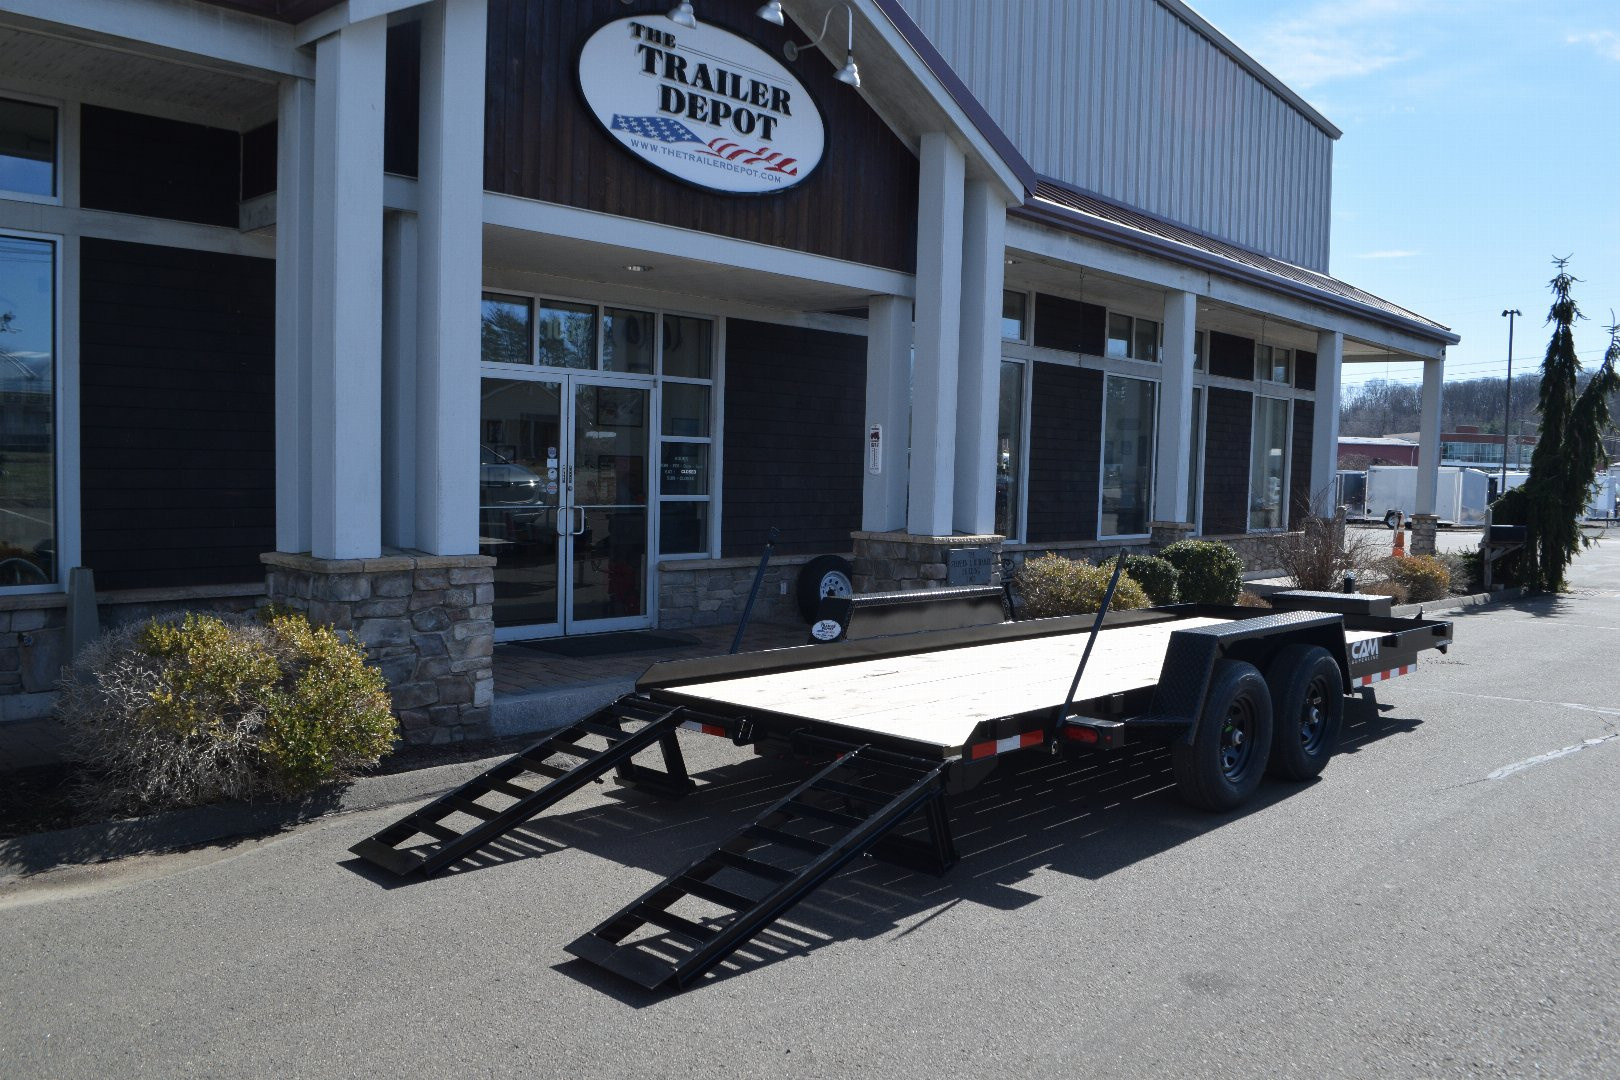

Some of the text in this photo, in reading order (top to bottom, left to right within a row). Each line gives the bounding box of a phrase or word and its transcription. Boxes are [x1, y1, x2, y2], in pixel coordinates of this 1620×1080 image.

[630, 22, 676, 49] THE
[637, 44, 792, 117] TRAILER
[658, 84, 777, 141] DEPOT
[630, 138, 782, 184] WWW.THETRAILERDEPOT.COM
[1352, 638, 1379, 660] CAM
